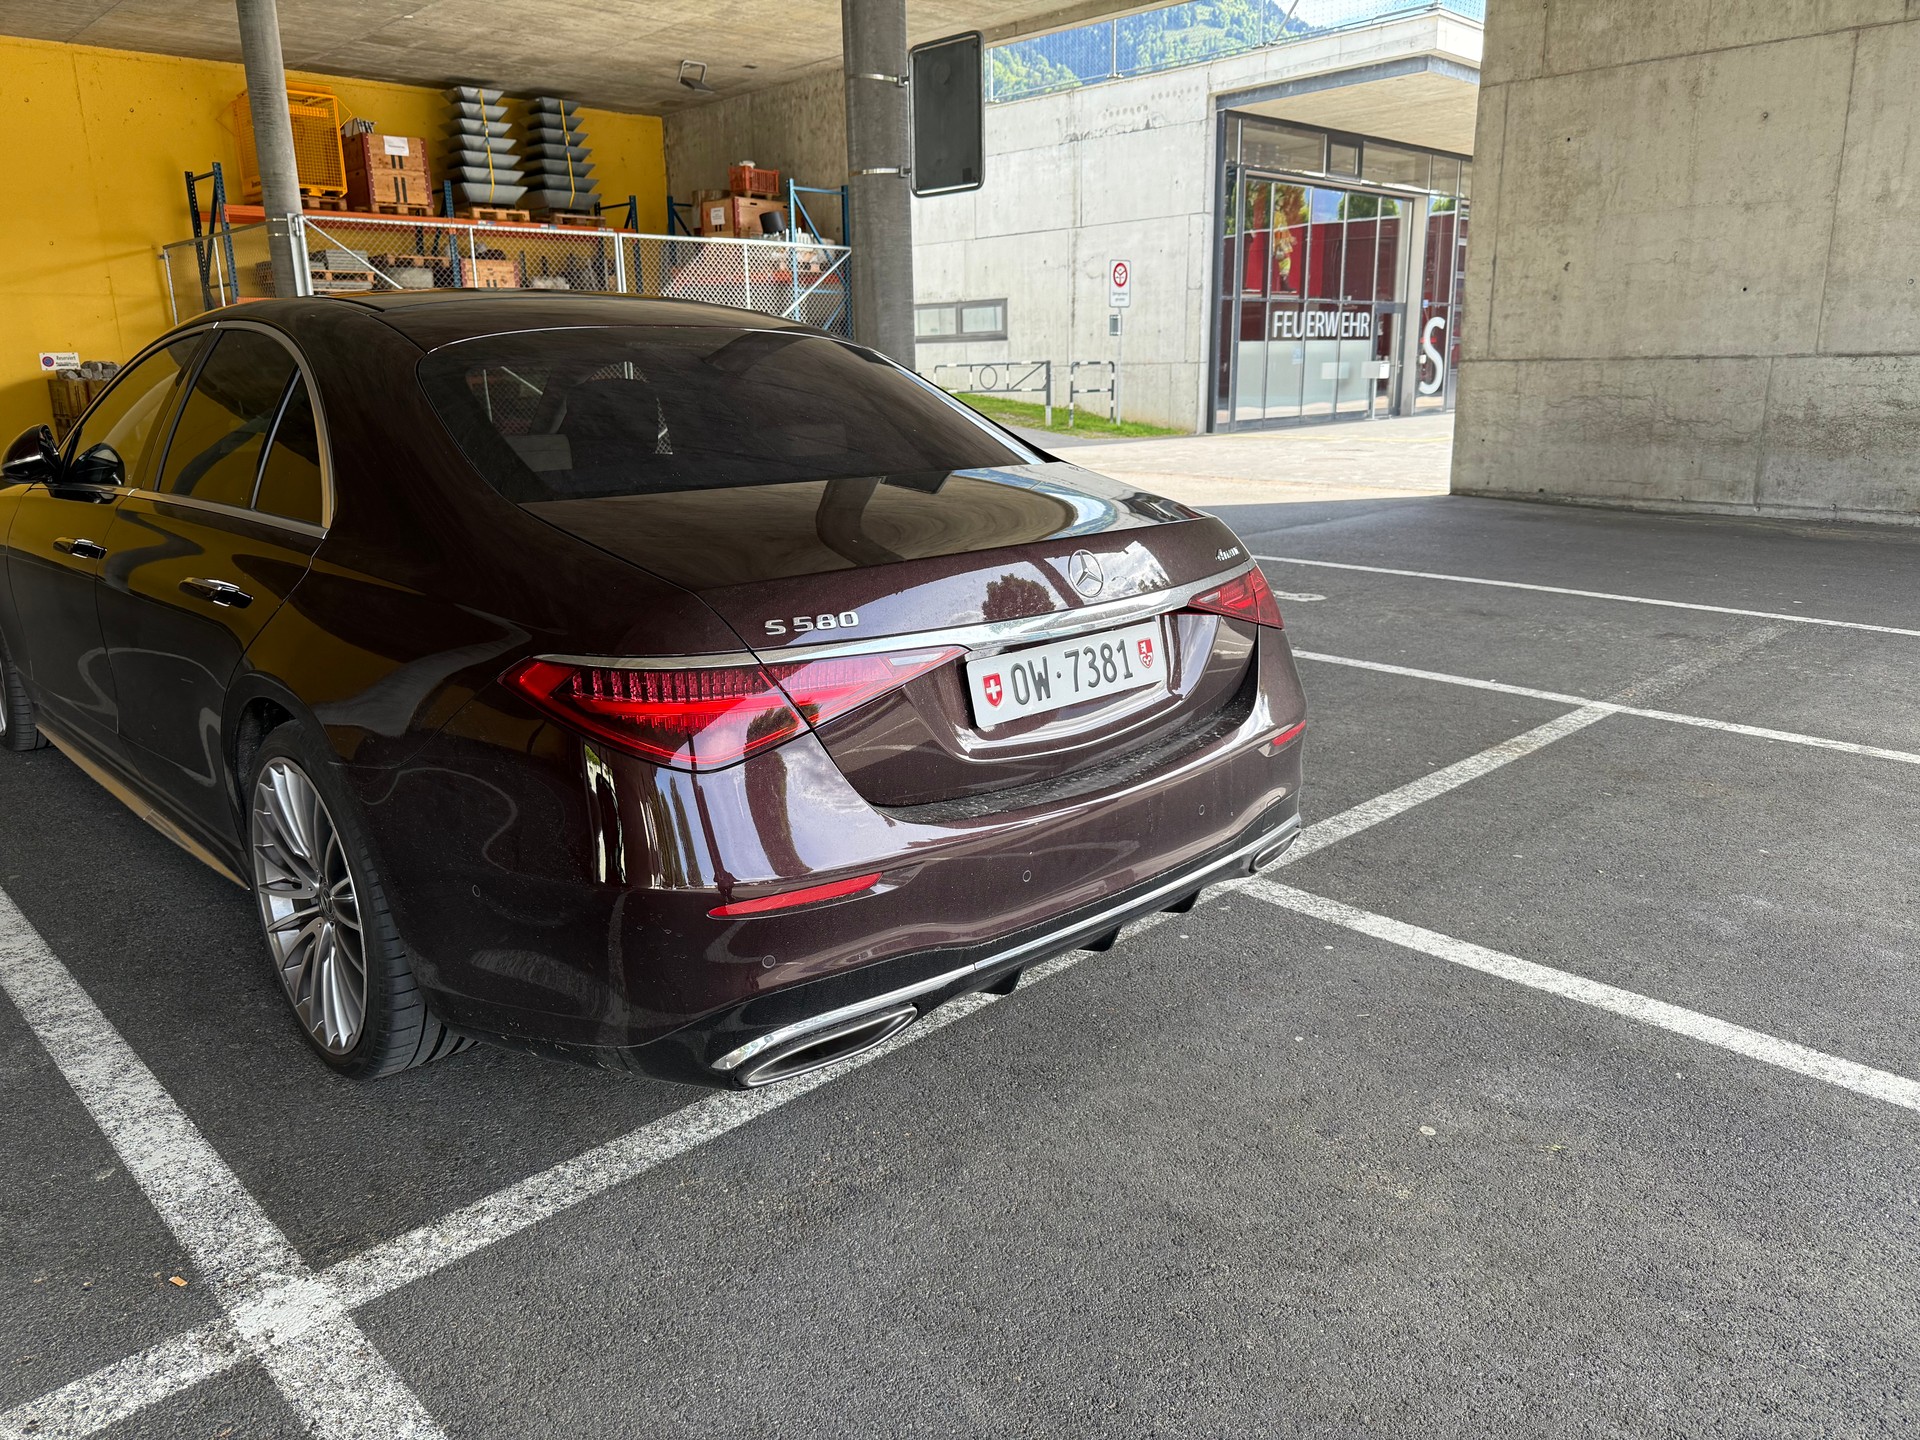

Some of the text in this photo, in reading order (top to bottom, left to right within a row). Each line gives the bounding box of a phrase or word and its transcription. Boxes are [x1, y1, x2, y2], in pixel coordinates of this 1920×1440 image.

[1273, 311, 1371, 338] FEUERWEHR
[764, 611, 859, 635] S 580
